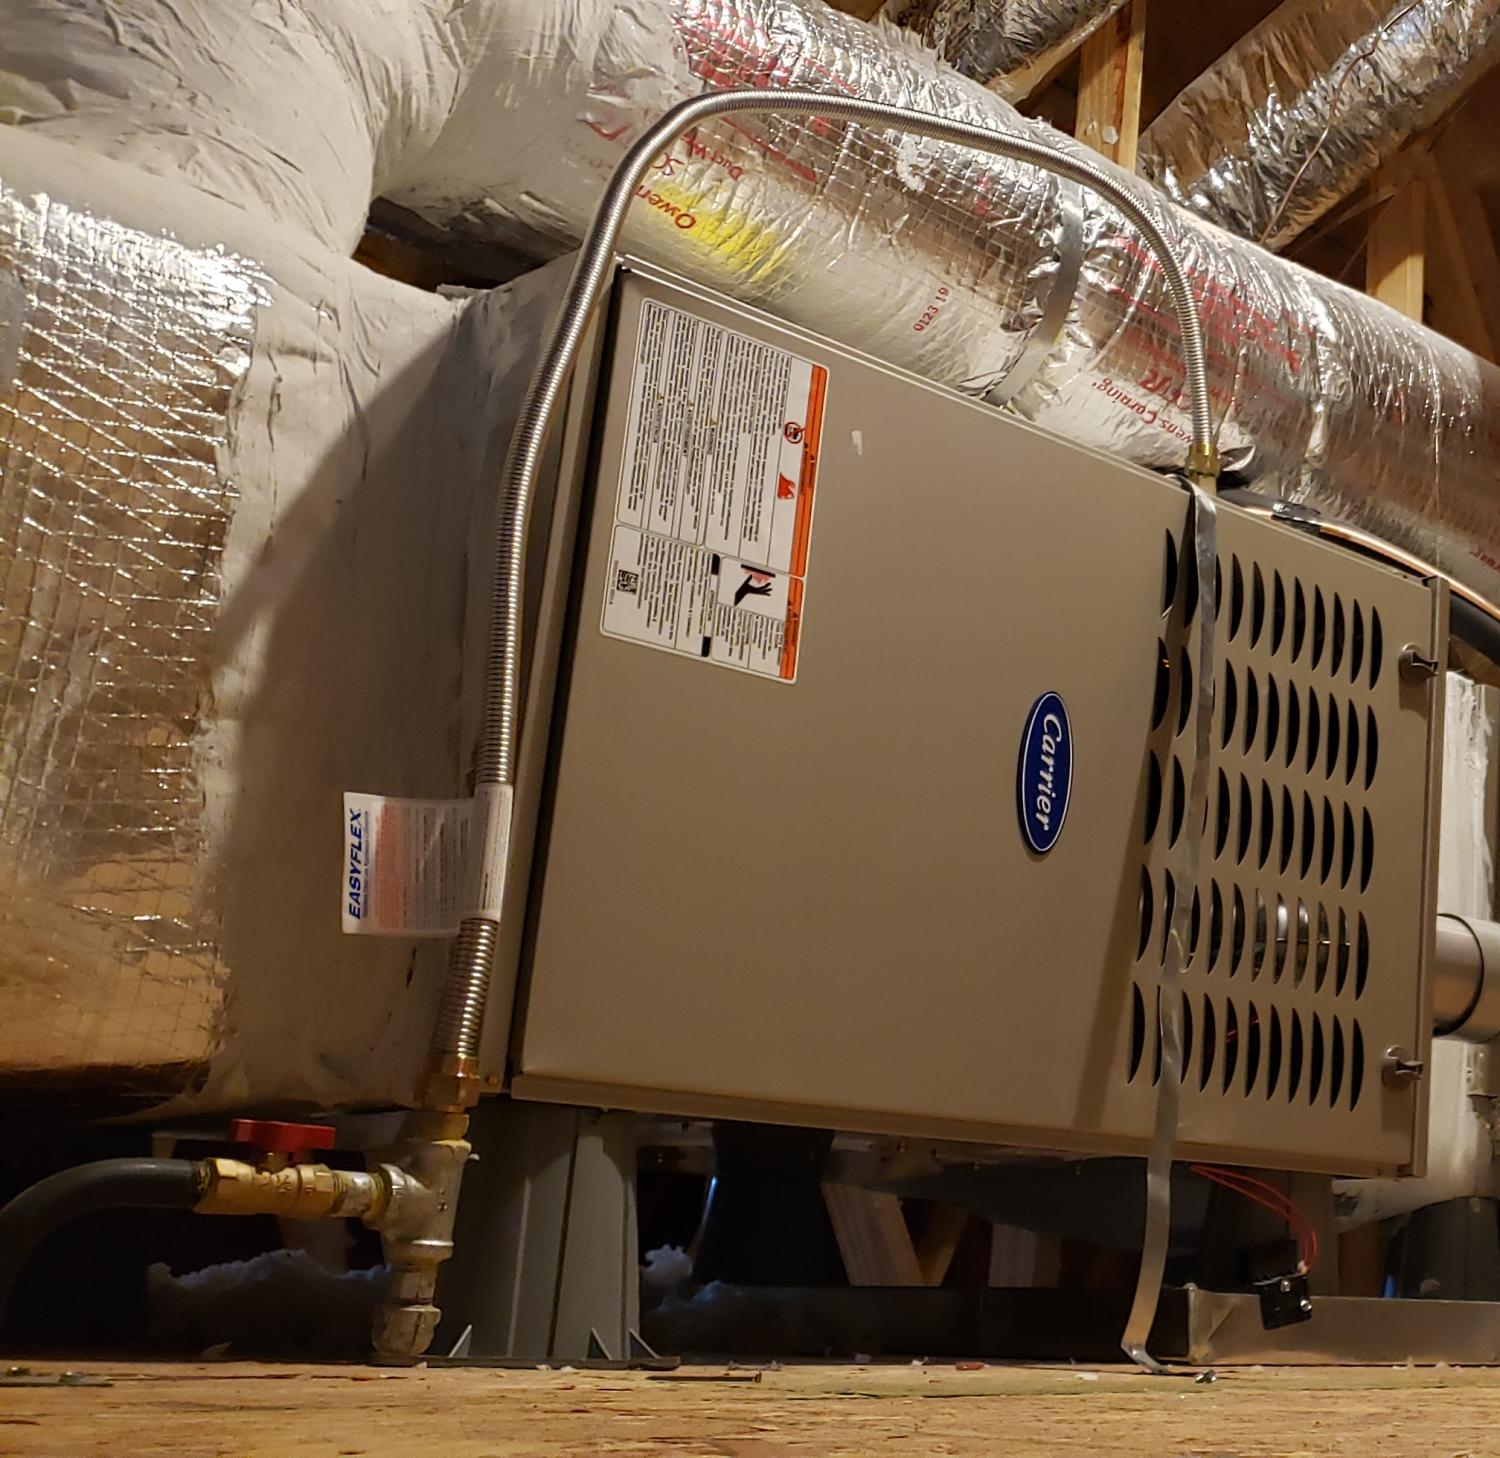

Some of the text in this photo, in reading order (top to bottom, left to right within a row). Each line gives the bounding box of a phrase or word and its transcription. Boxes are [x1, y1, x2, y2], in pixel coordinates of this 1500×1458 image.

[634, 184, 697, 229] Owen
[1035, 712, 1063, 832] Carrier
[349, 807, 362, 920] EASYFLEX
